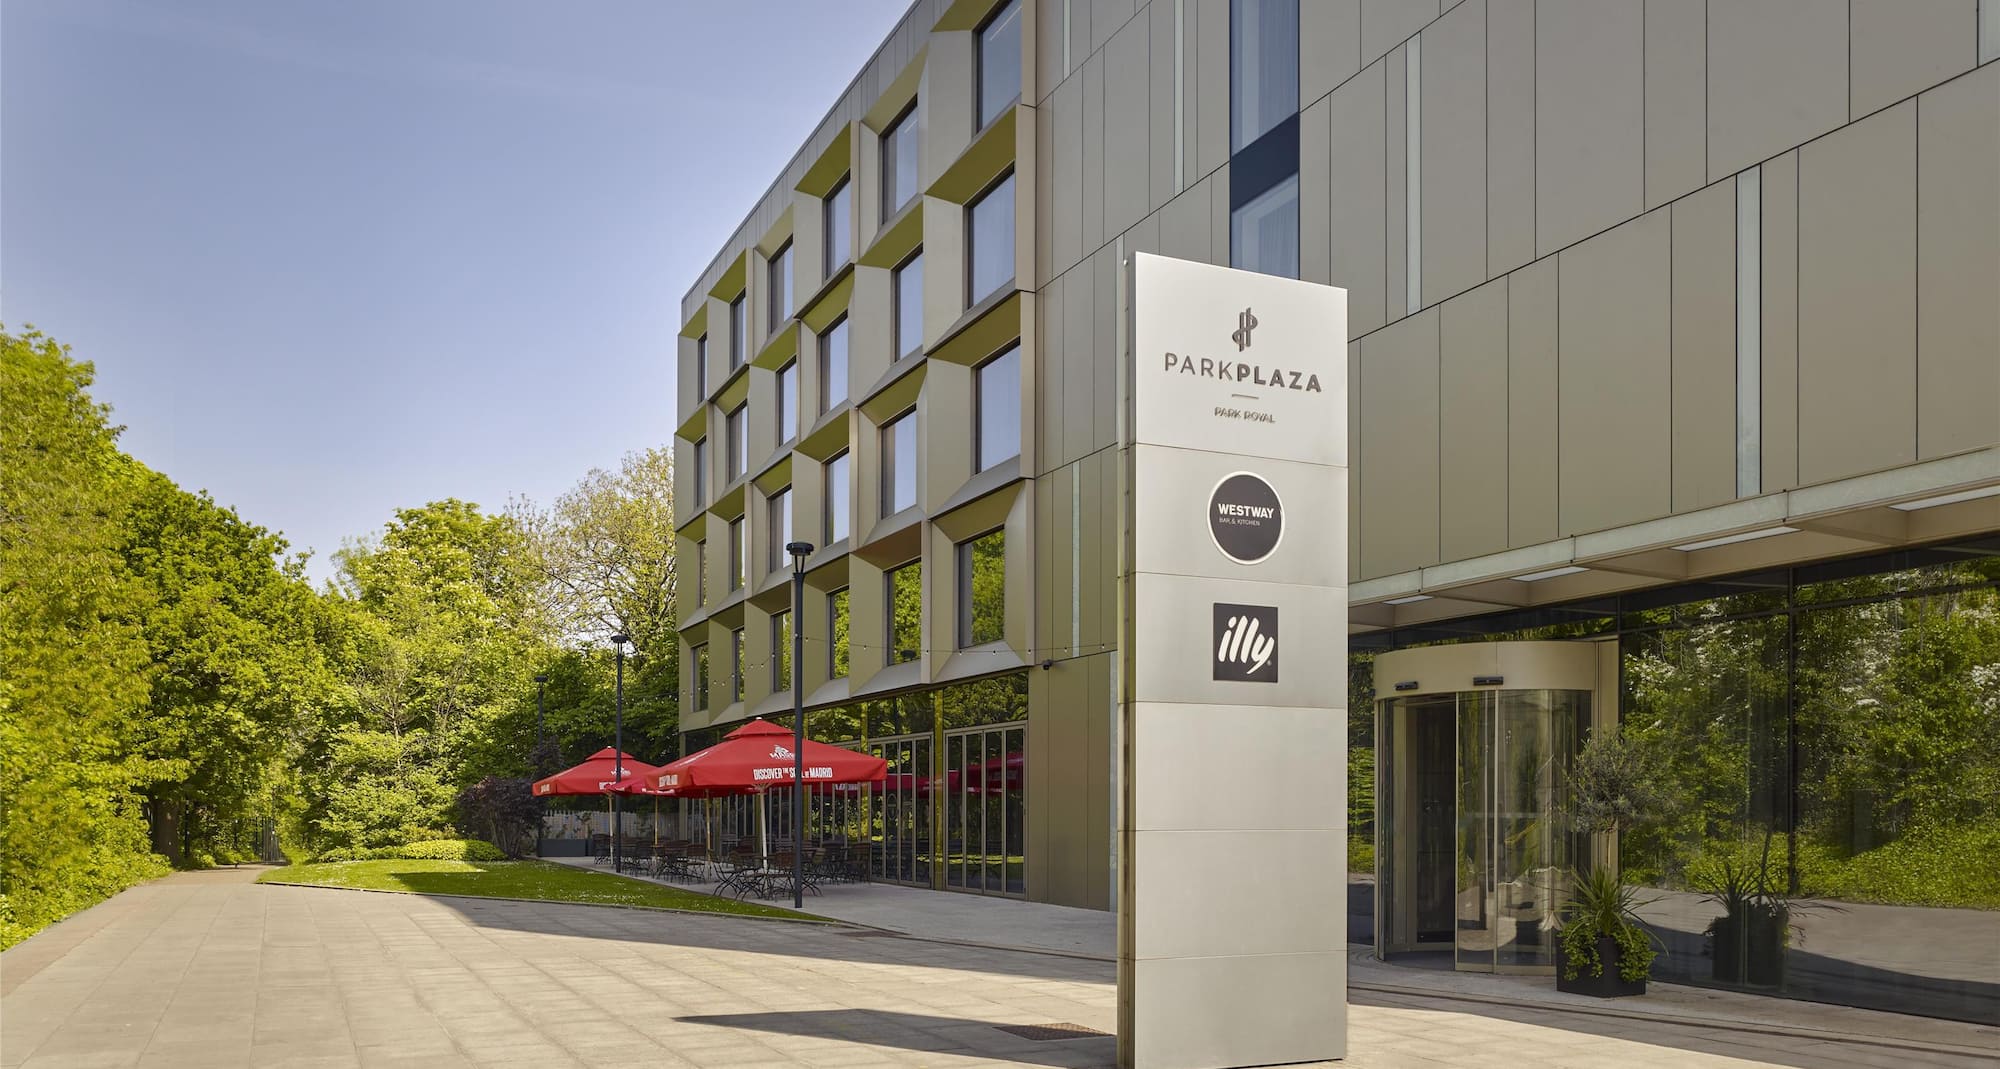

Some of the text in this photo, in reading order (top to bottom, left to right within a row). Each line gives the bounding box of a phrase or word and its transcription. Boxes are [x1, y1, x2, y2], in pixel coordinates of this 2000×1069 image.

[1164, 352, 1322, 393] PARKPLAZA
[1214, 406, 1276, 424] PARK ROYAL
[1218, 503, 1274, 519] WESTWAY
[1237, 518, 1261, 527] KITCHEN
[1218, 615, 1275, 675] illy
[753, 767, 783, 780] DISCOVER
[789, 767, 804, 778] SOL
[809, 767, 832, 778] MADRID
